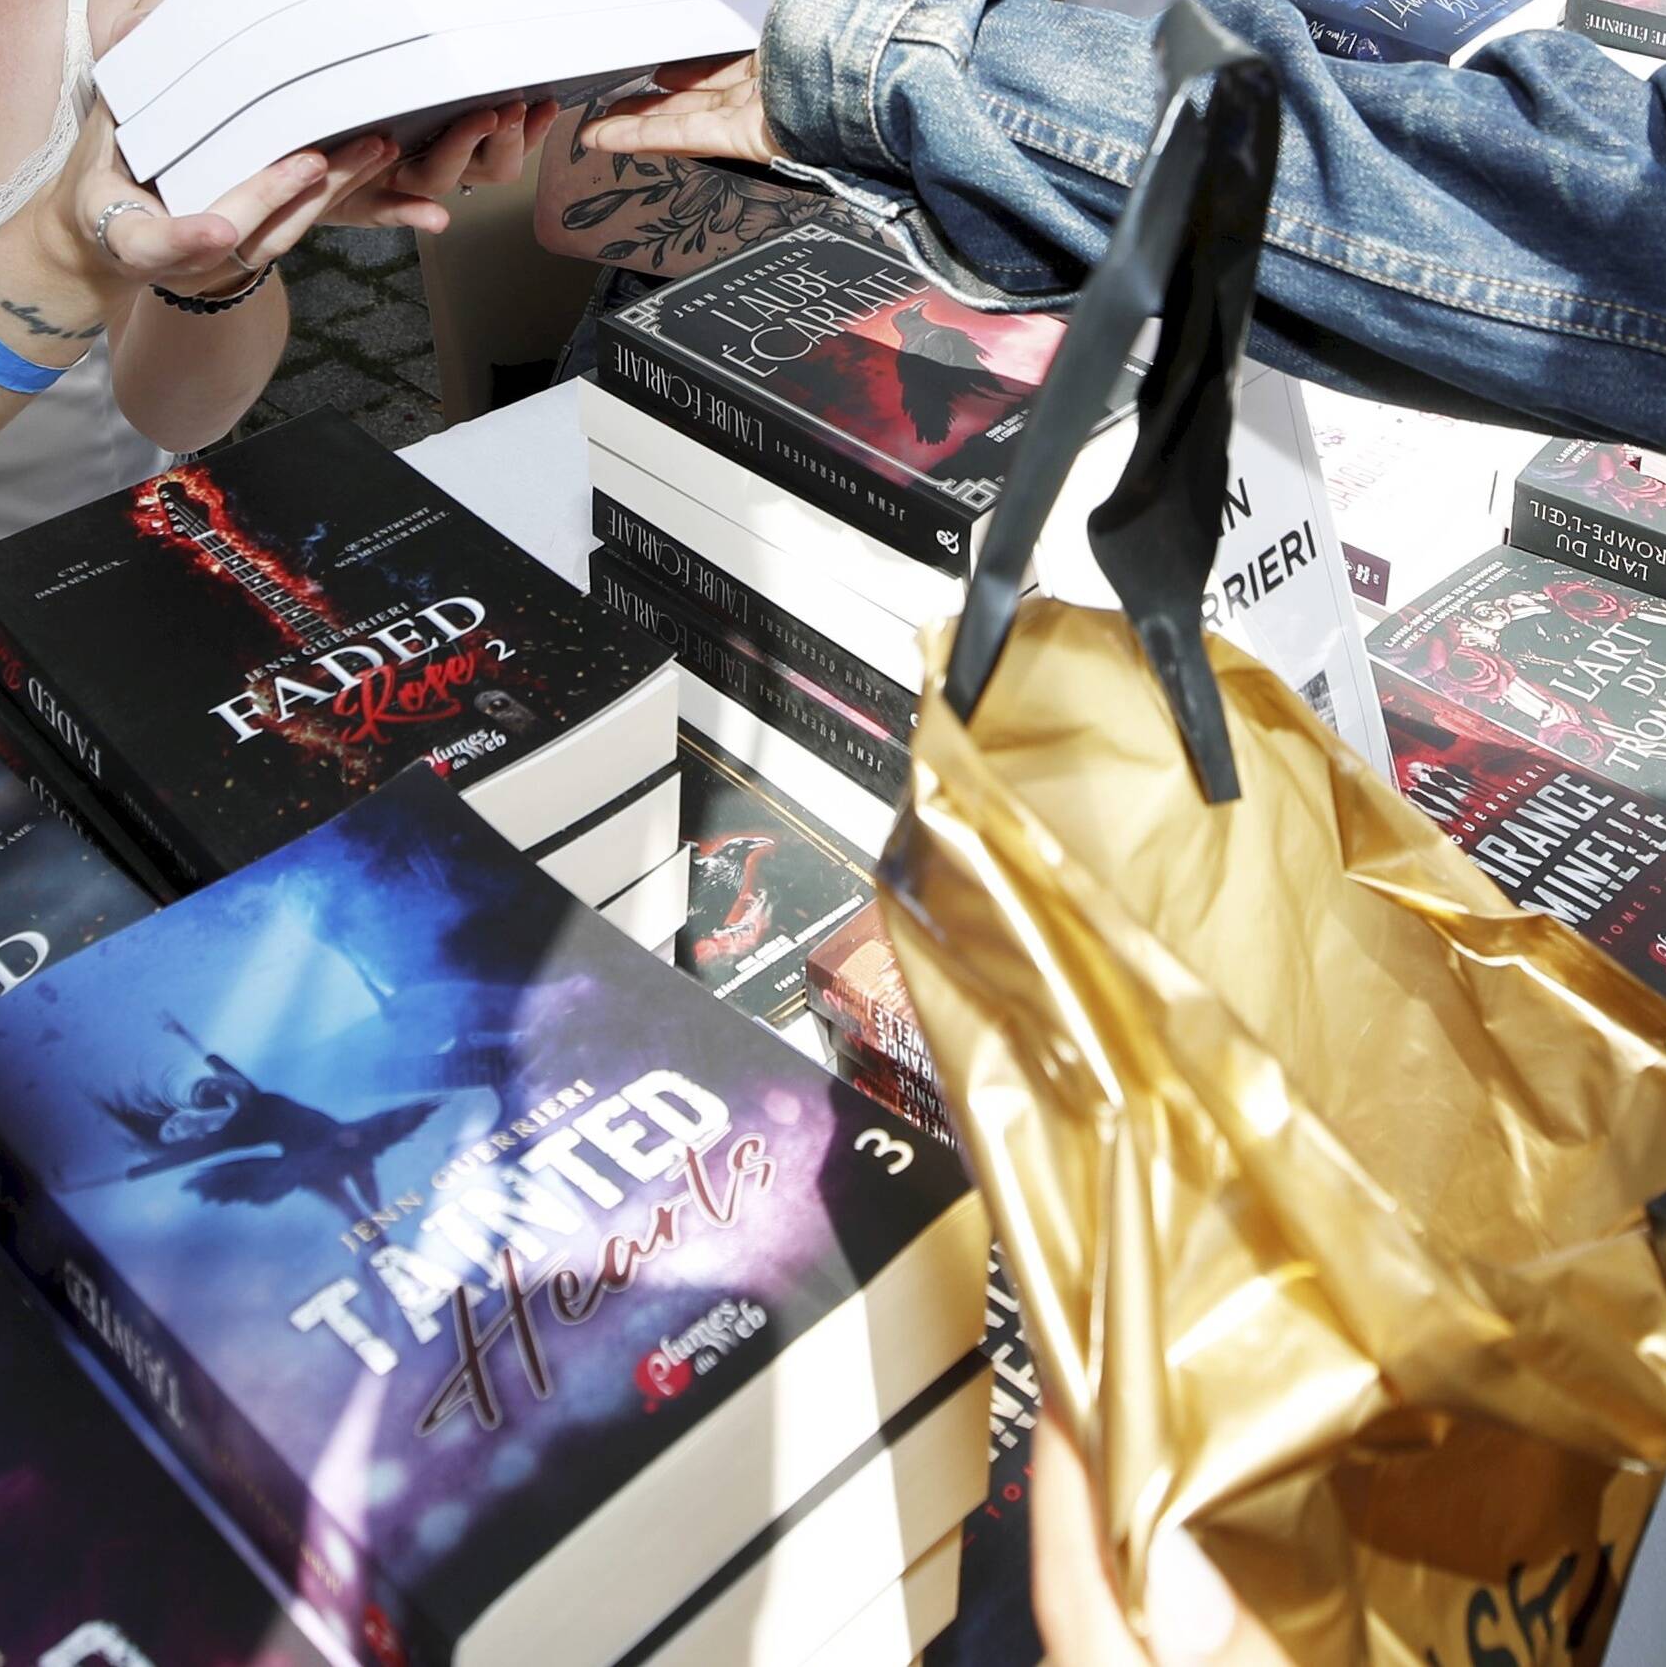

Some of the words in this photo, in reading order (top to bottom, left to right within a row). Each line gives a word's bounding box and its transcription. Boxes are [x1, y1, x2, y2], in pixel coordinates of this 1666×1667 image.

[673, 291, 719, 321] JENN
[722, 246, 814, 294] GUERRIERI
[710, 262, 851, 333] L'AUBE
[721, 267, 931, 379] ÉCARLATE
[612, 340, 703, 422] ÉCARLATE
[705, 391, 765, 453] L'AUBE
[774, 438, 858, 496] GUERRIERI
[373, 507, 430, 539] ENTREVOIT
[866, 489, 907, 523] JENN
[57, 560, 89, 578] C'EST
[334, 556, 358, 568] SON
[357, 532, 410, 558] MEILLEUR
[606, 505, 692, 588] ÉCARLATE
[1201, 519, 1318, 632] RRIERI
[1555, 533, 1588, 558] DU
[1593, 550, 1648, 583] L'ART
[35, 583, 67, 600] DANS
[66, 574, 89, 586] SES
[693, 562, 749, 625] L'AUBE
[206, 596, 487, 745] FADED
[244, 653, 297, 684] JENN
[300, 601, 411, 657] GUERRIERI
[1401, 630, 1423, 650] AVEC
[1419, 620, 1436, 634] LES
[1549, 620, 1653, 703] L'ART
[333, 649, 480, 745] Rose
[483, 638, 517, 663] 2
[844, 669, 883, 704] JENN
[27, 676, 102, 780] FADED
[845, 739, 885, 774] JENN
[1447, 763, 1548, 847] GUERRIERI
[1467, 772, 1615, 889] RANCE
[1599, 900, 1647, 946] TOME
[1648, 884, 1662, 896] 3
[340, 1189, 425, 1255] JENN
[431, 1078, 597, 1191] GUERRIERI
[852, 1125, 917, 1177] 3
[289, 1068, 733, 1378] TAINTED
[415, 1131, 780, 1439] Hearts
